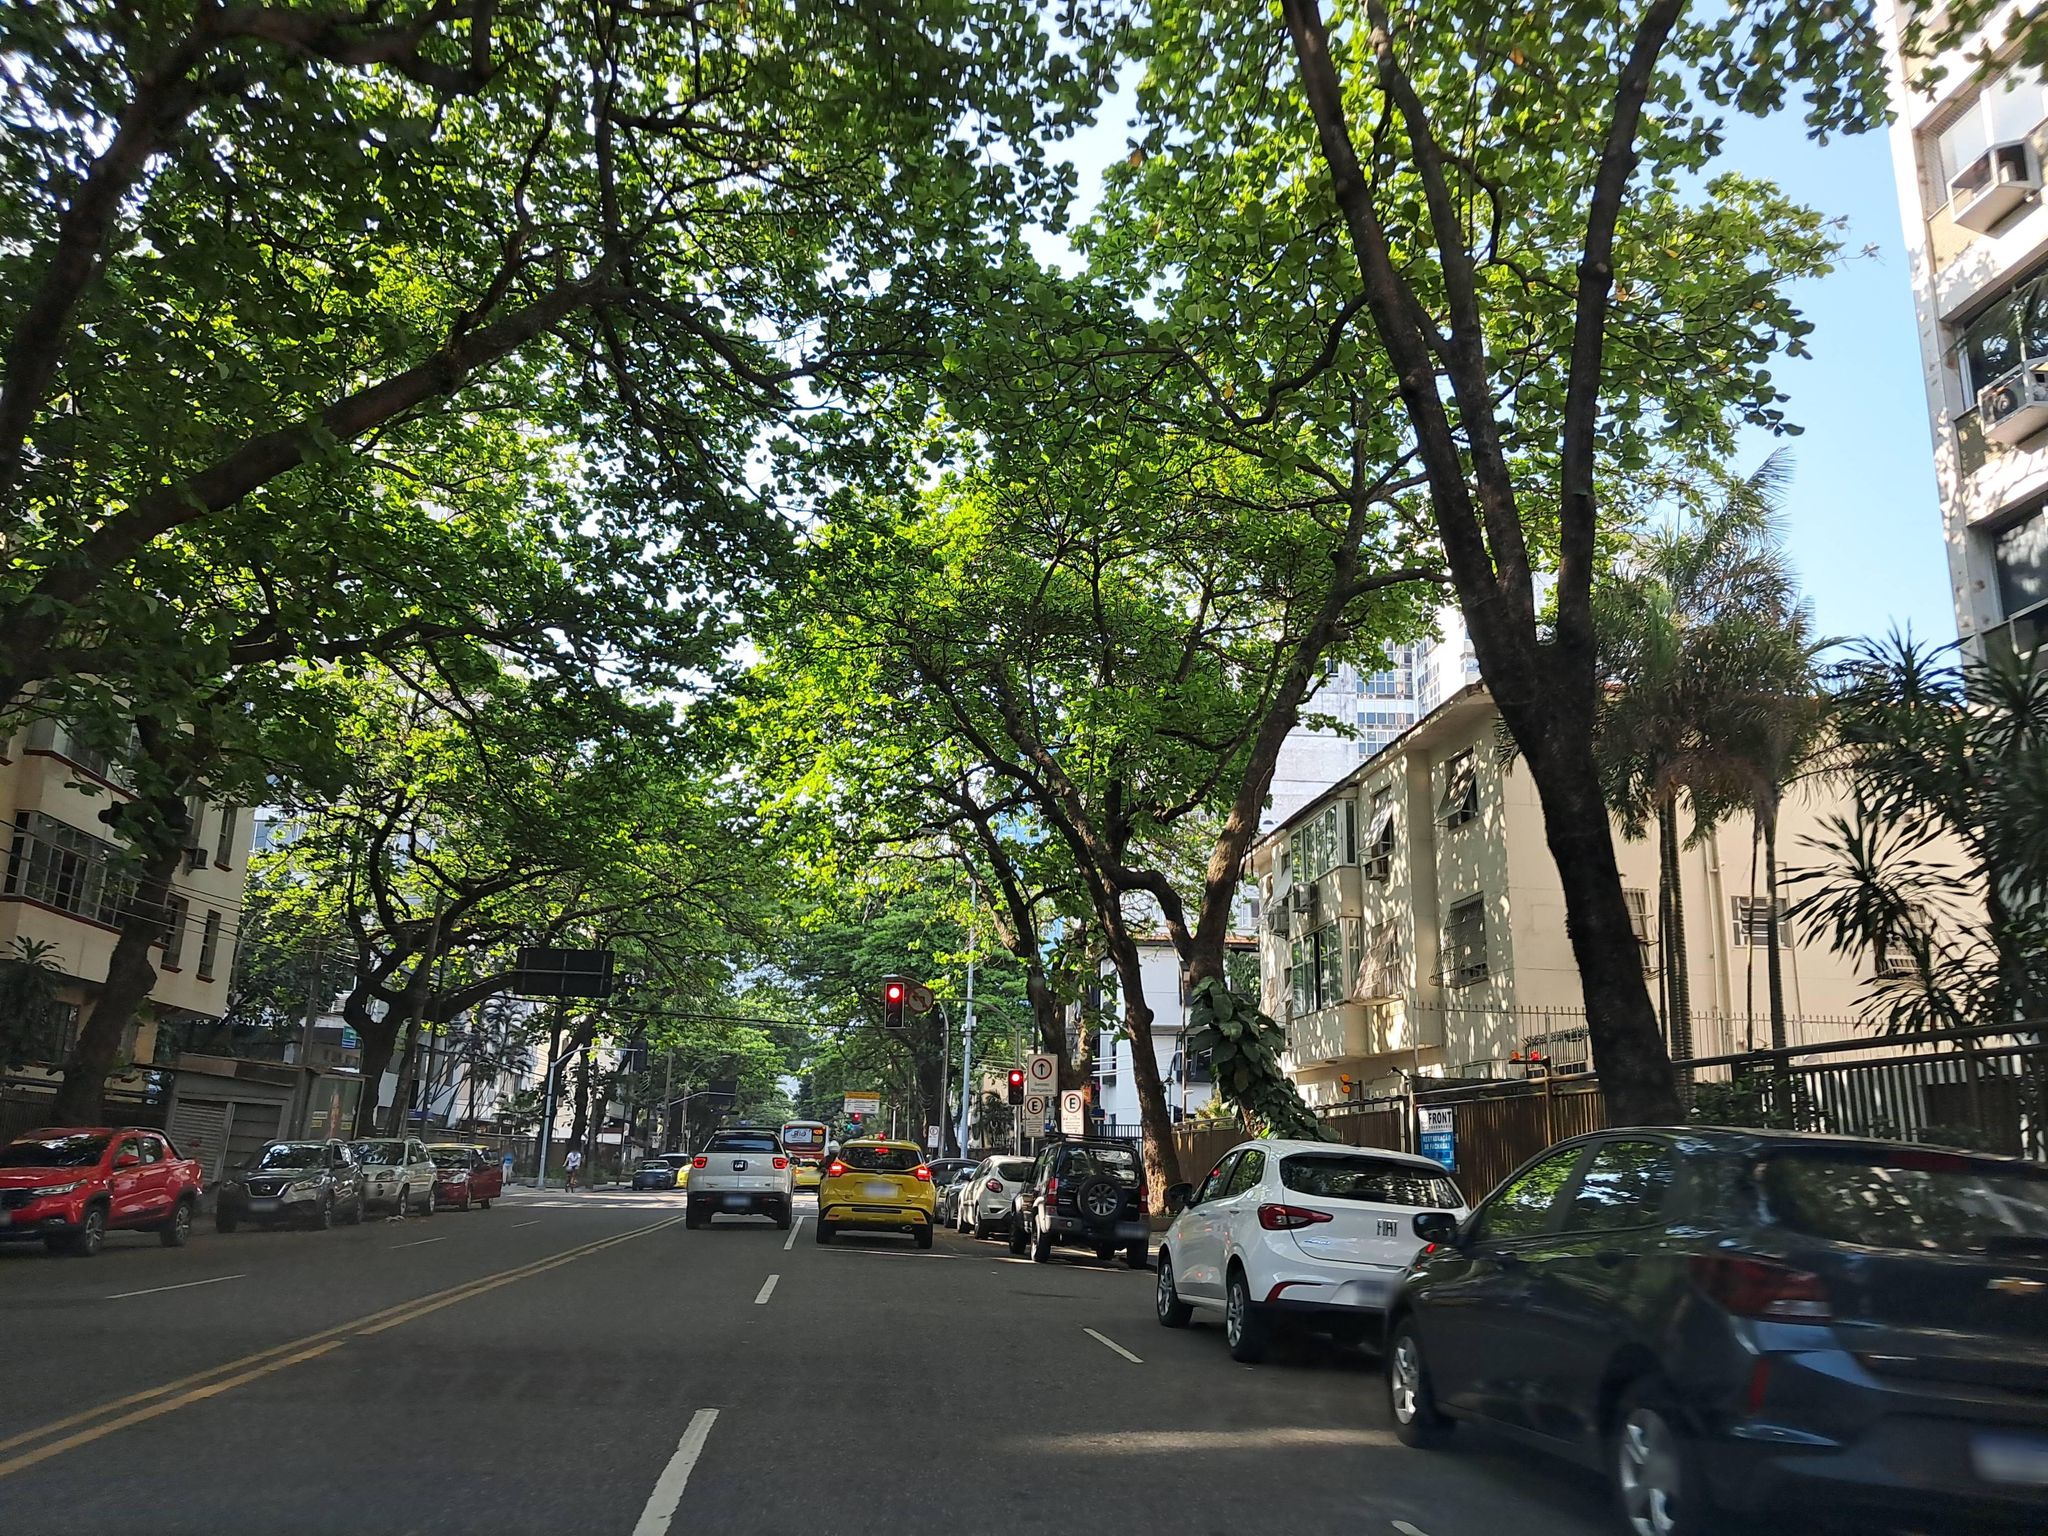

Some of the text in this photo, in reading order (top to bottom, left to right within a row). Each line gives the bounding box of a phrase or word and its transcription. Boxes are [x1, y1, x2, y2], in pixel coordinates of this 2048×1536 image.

[1032, 1101, 1038, 1111] E
[1069, 1098, 1076, 1109] E
[1428, 1111, 1451, 1125] FRONT
[1377, 1219, 1398, 1237] FIAT
